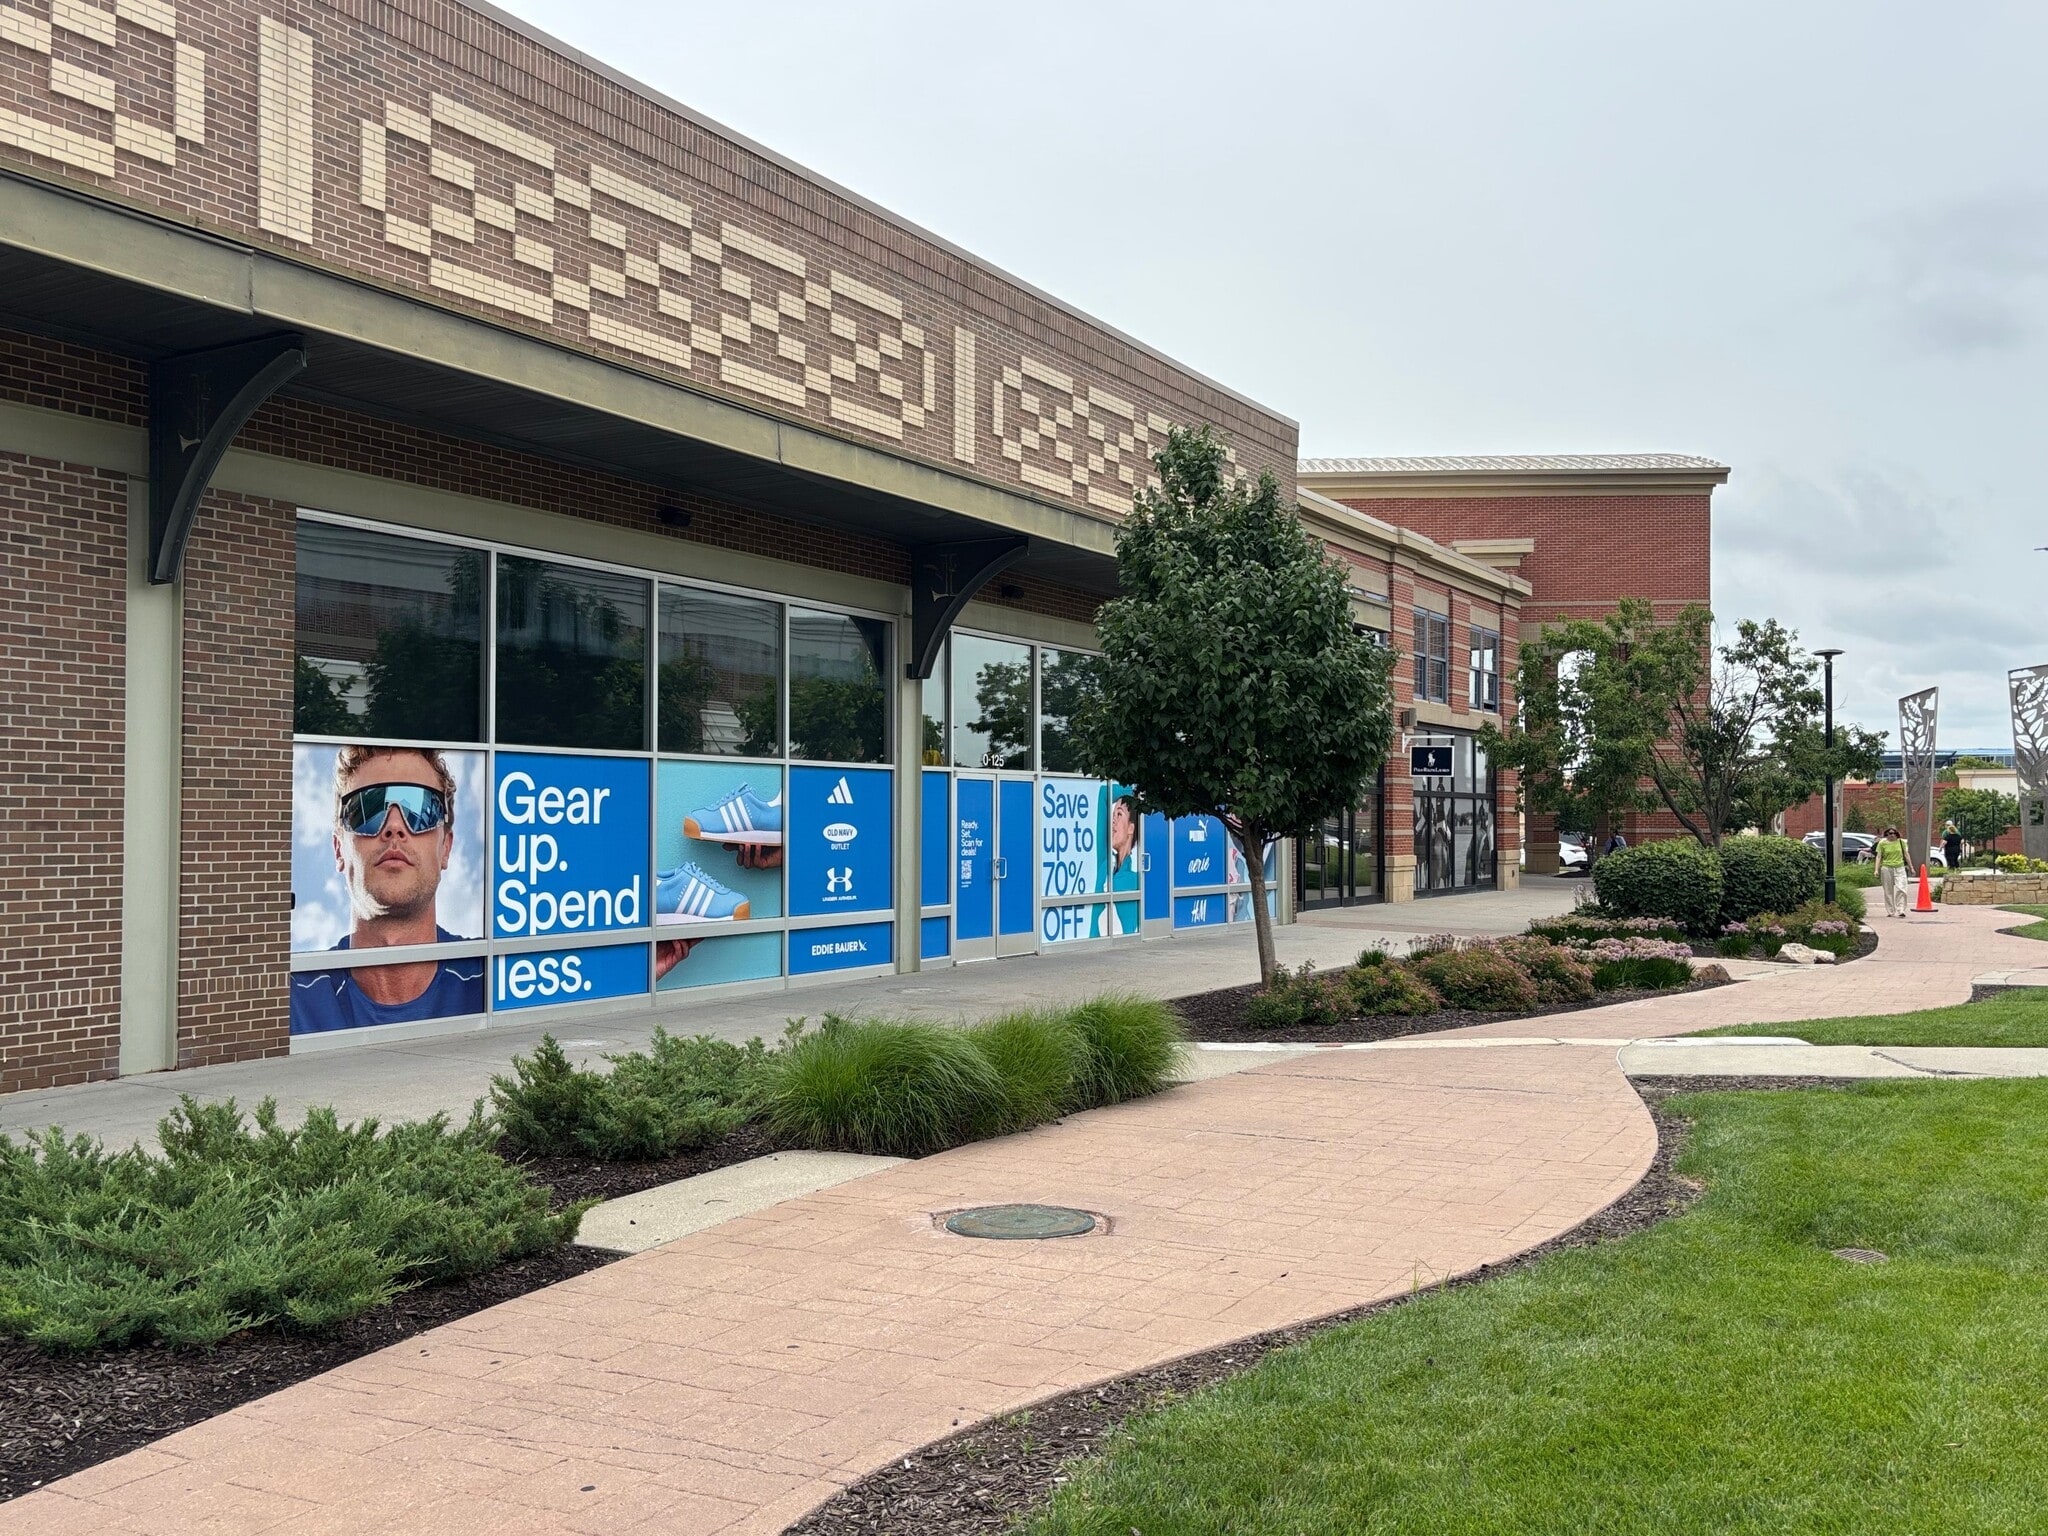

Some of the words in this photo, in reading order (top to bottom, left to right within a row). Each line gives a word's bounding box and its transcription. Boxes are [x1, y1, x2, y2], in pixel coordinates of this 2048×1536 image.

[982, 753, 1005, 767] 0-125
[498, 771, 610, 825] Gear
[1042, 783, 1089, 819] Save
[827, 829, 838, 837] OLD
[838, 828, 854, 837] NAVY
[830, 843, 850, 851] OUTLET
[961, 838, 975, 847] Scan
[975, 837, 984, 847] for
[1043, 828, 1069, 861] up
[1073, 820, 1094, 852] to
[498, 834, 568, 885] up.
[1188, 852, 1210, 874] aerie
[1042, 860, 1086, 896] 70%
[497, 874, 640, 936] Spend
[1043, 905, 1085, 942] OFF
[811, 943, 834, 956] EDDIE
[834, 940, 858, 953] BAUER
[498, 954, 593, 1002] less.
